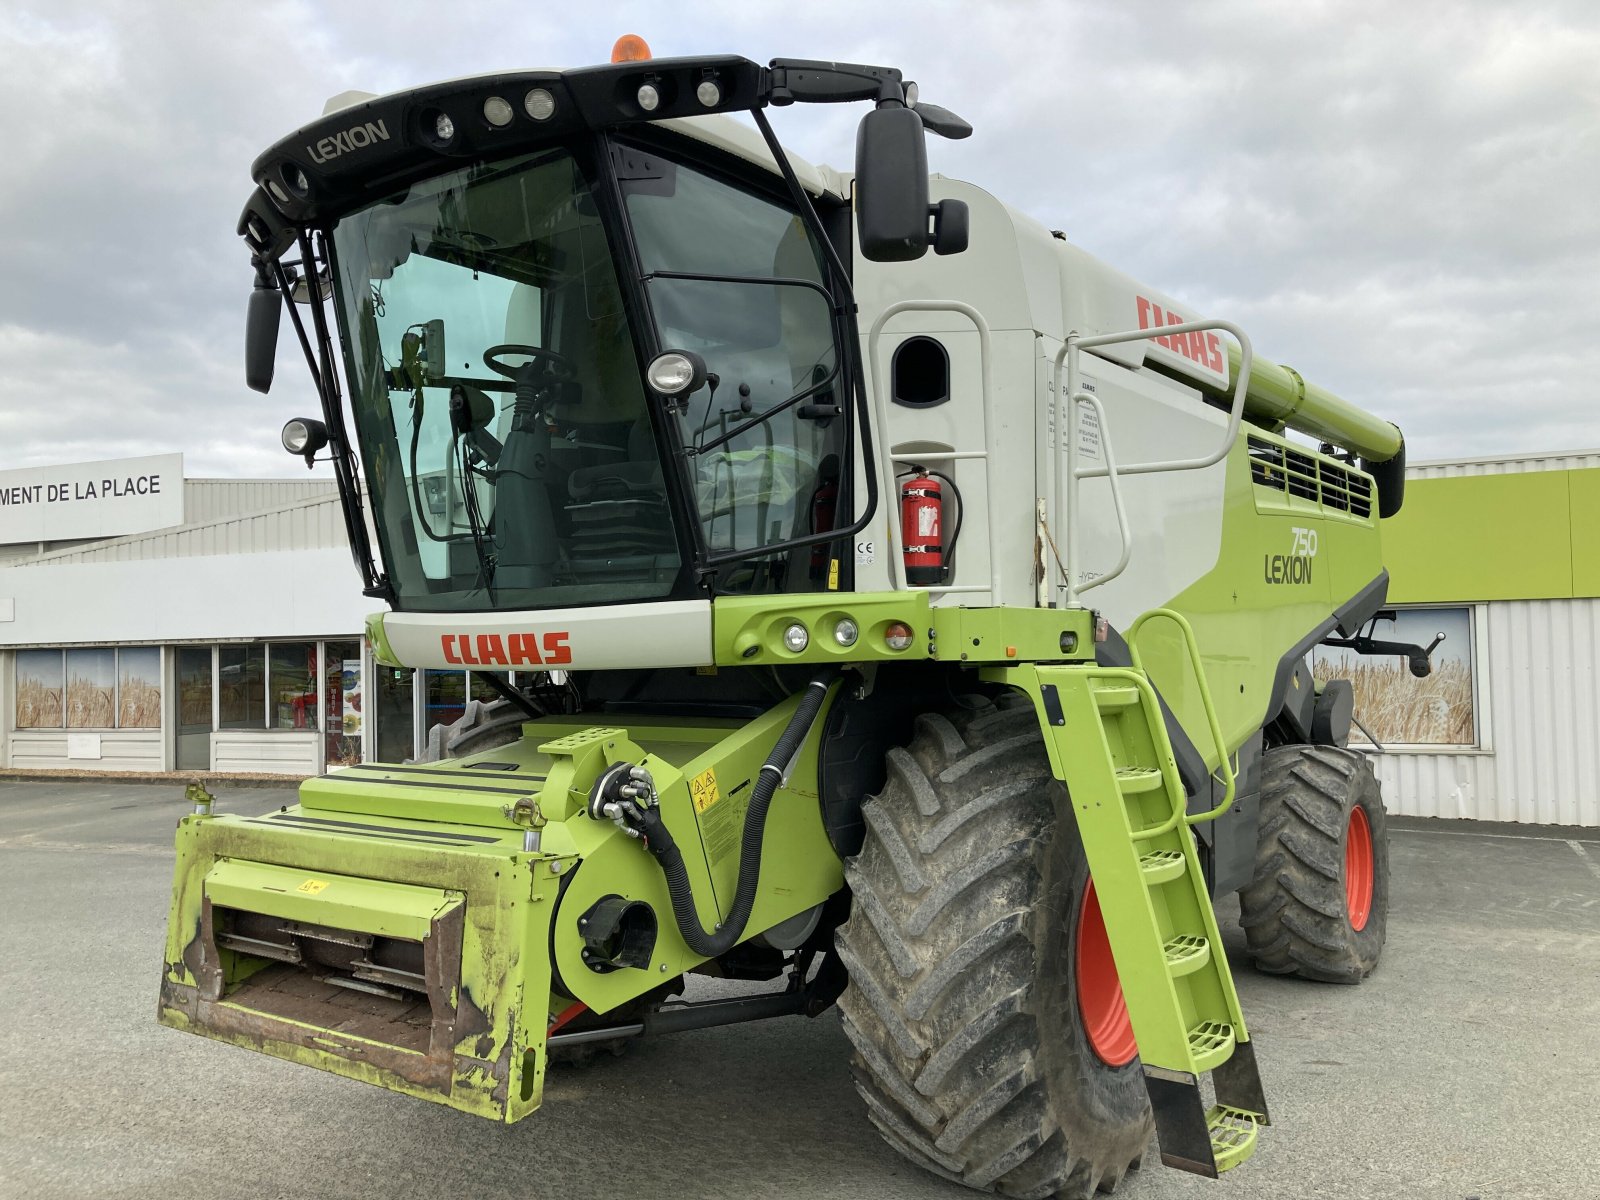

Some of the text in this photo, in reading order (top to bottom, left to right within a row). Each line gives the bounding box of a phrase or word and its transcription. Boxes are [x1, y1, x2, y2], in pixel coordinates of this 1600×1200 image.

[306, 119, 390, 164] LEXION
[1136, 295, 1223, 374] CLAAS
[0, 475, 160, 505] MENT DE LA PLACE
[1291, 527, 1318, 557] 750
[1265, 554, 1312, 584] LEXION
[441, 632, 572, 665] CLAAS
